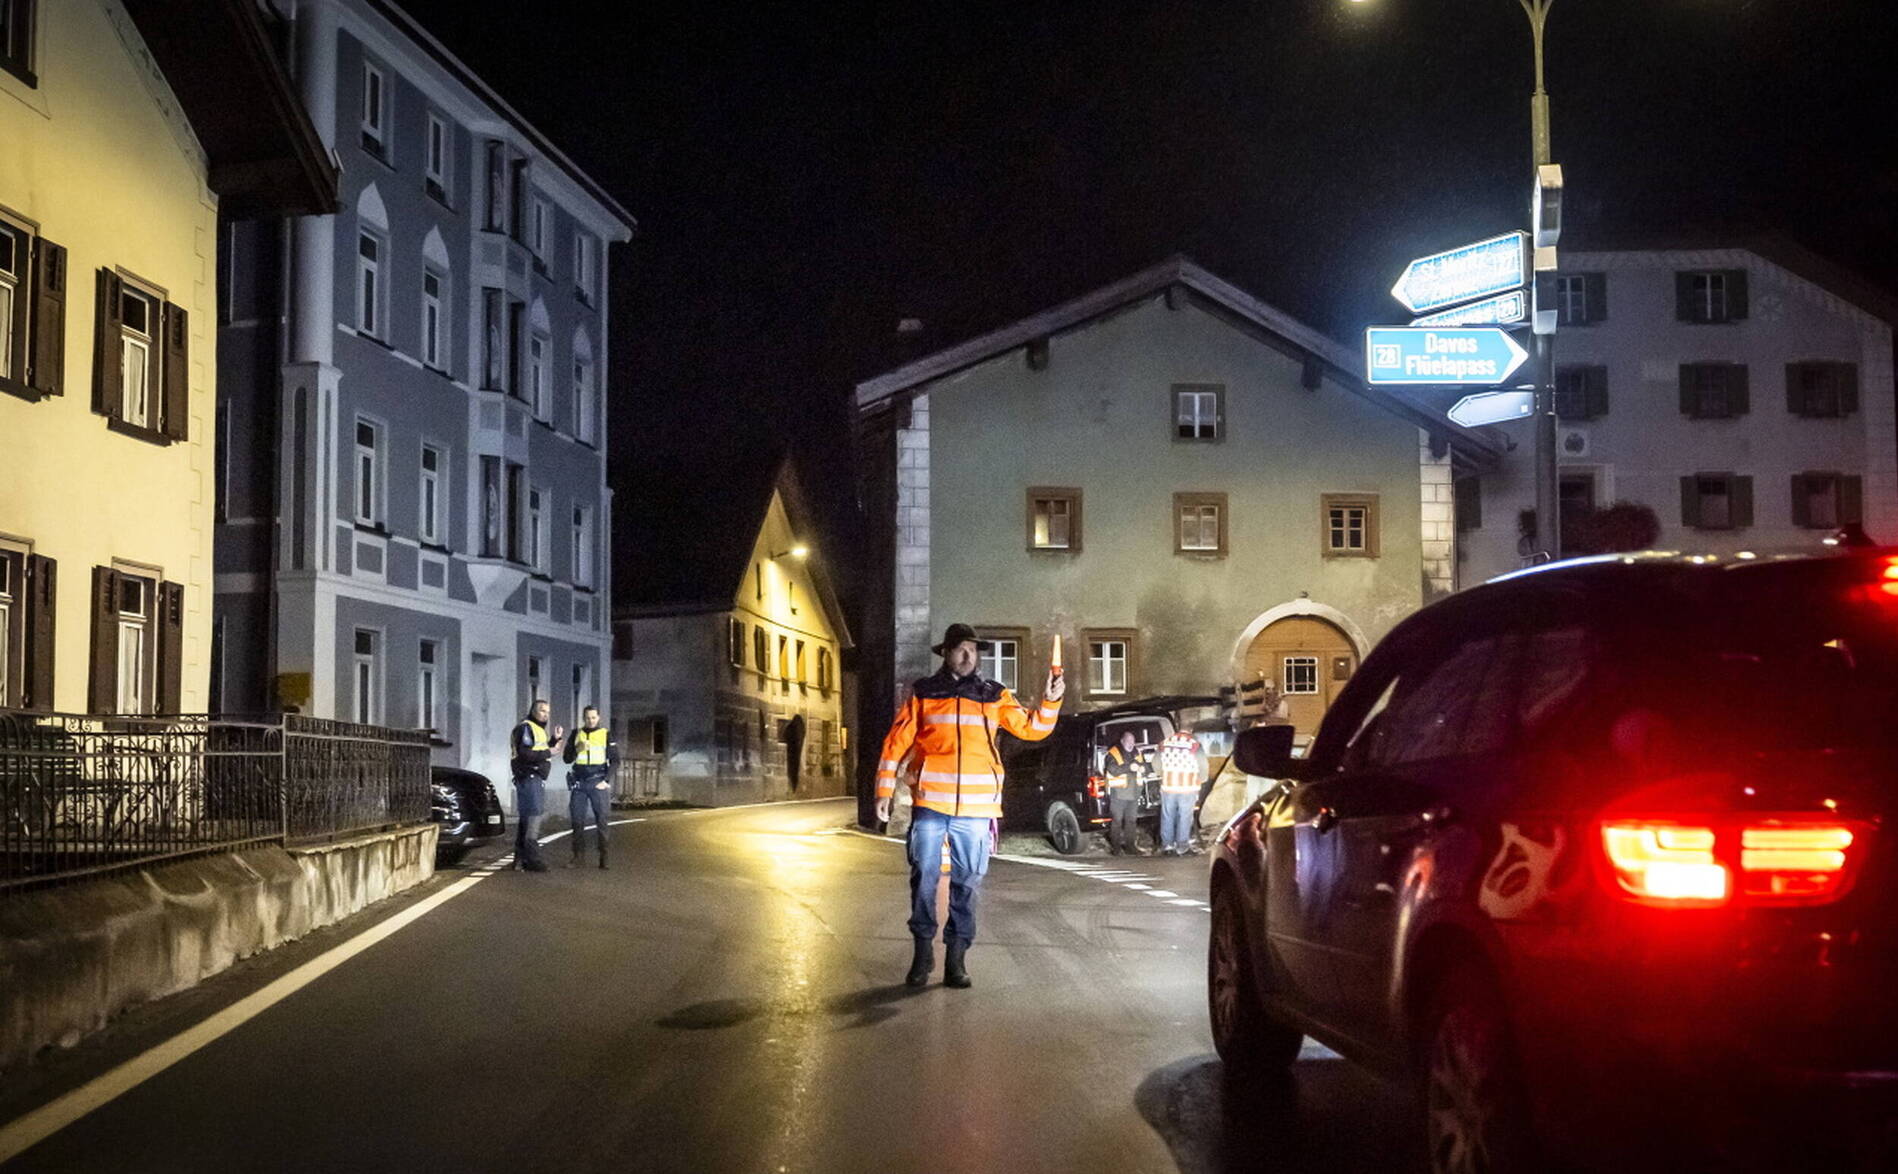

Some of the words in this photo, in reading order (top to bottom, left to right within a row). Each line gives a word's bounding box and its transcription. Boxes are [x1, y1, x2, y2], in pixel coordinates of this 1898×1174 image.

[1425, 333, 1478, 353] Davos
[1377, 348, 1395, 364] 28
[1406, 355, 1497, 379] Flüelapass
